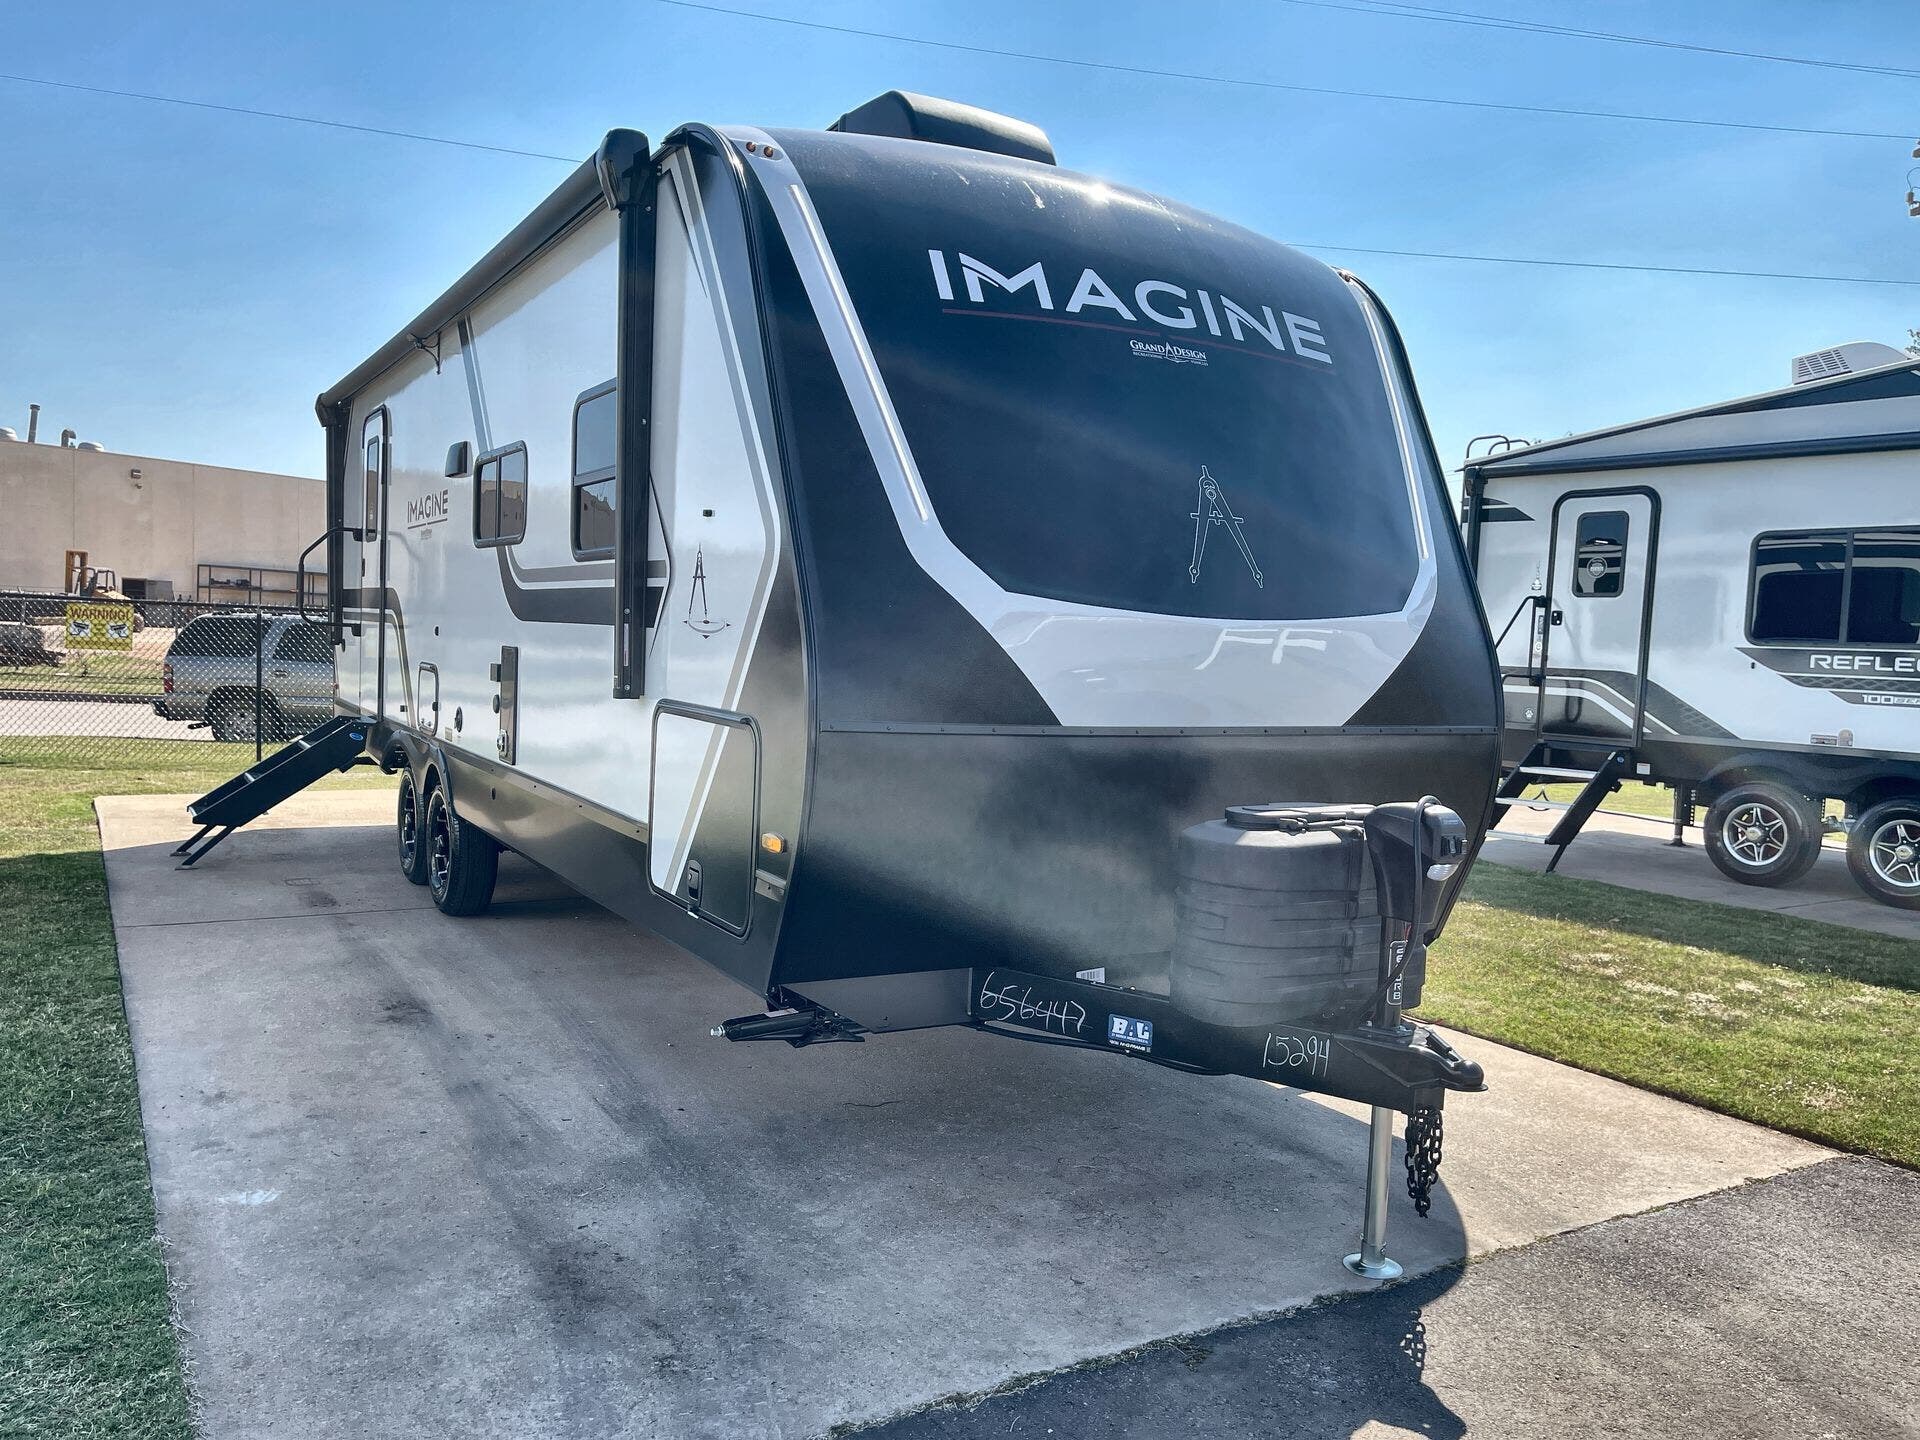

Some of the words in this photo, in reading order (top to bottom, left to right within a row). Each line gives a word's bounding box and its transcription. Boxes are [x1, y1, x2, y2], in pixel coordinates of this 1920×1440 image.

[928, 249, 1333, 364] IMAGINE
[1130, 340, 1165, 352] GRAND
[1174, 347, 1207, 359] DESIGN
[407, 489, 449, 523] IMAGINE
[70, 608, 129, 620] WARNING!
[1810, 655, 1920, 672] REFLE
[1862, 694, 1894, 704] 100
[980, 971, 1093, 1034] 656447
[1262, 1032, 1331, 1077] 15294
